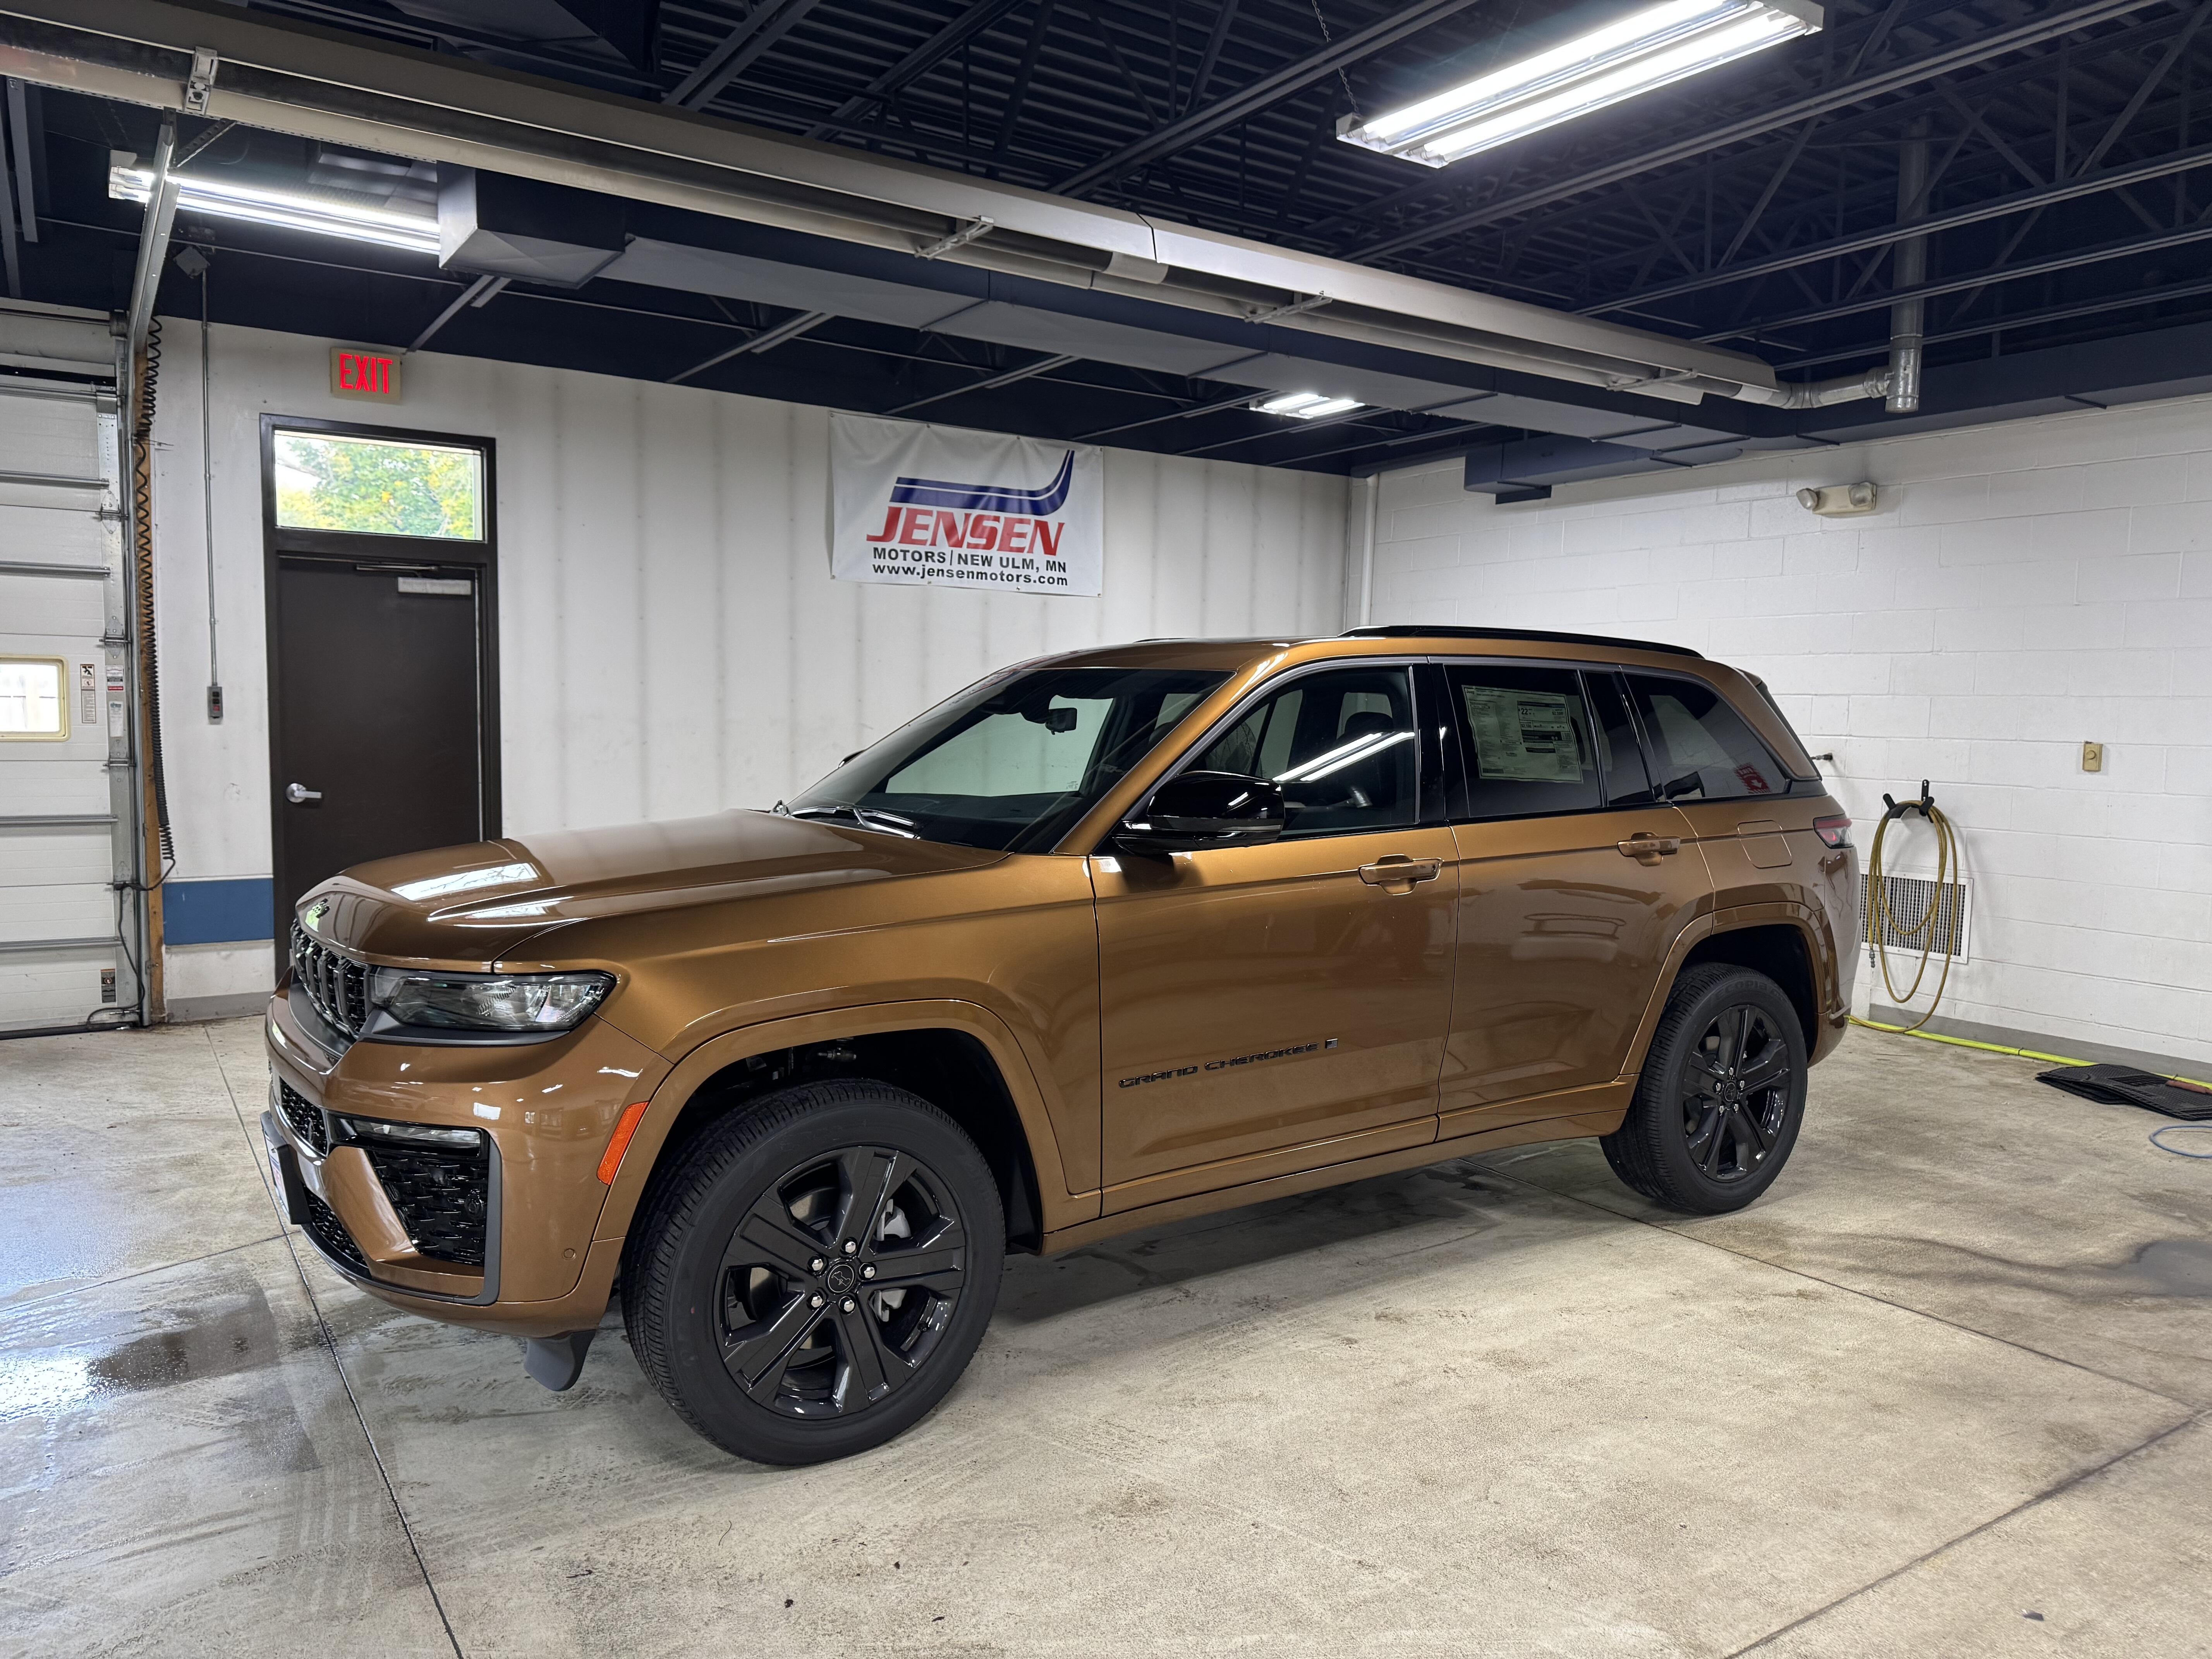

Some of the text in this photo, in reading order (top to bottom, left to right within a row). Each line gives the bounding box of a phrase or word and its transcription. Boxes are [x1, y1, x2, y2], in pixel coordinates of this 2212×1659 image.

[340, 353, 393, 394] EXIT
[866, 506, 1065, 556] JENSEN
[872, 564, 1068, 586] www.jensenmotors.com
[873, 547, 1066, 573] MOTORS NEW ULM, MN
[1119, 1042, 1319, 1088] GRAND CHEROKEE
